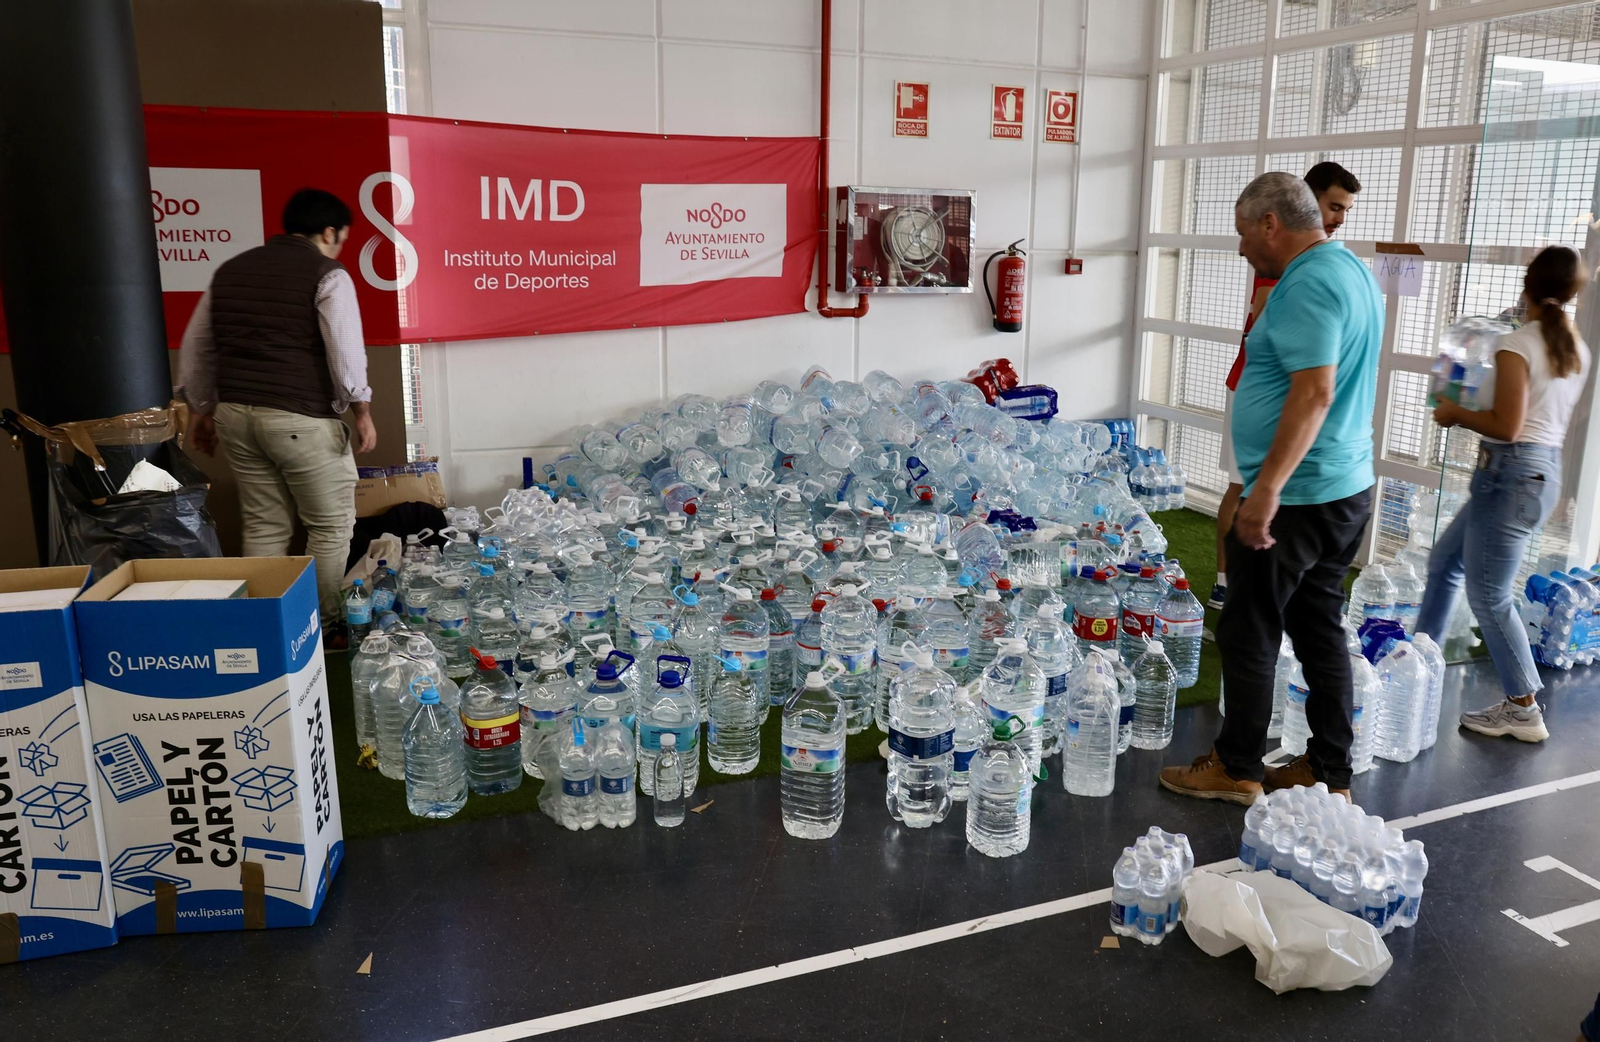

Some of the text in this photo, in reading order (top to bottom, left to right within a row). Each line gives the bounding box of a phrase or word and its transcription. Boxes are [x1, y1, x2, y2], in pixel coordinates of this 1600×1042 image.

[897, 128, 926, 136] INCENDIO
[994, 125, 1022, 137] EXTINTOR
[480, 176, 586, 222] IMD
[157, 229, 232, 243] MIENTO
[664, 231, 765, 245] AYUNTAMIENTO
[158, 248, 210, 262] VILLA
[444, 249, 617, 271] Instituto Municipal
[680, 246, 750, 261] DE SEVILLA
[1380, 256, 1416, 279] AGUA
[474, 271, 589, 293] de Deportes
[127, 655, 211, 671] LIPASAM
[132, 710, 246, 722] USA LAS PAPELERAS
[160, 740, 204, 865] PAPEL Y
[192, 737, 238, 868] CARTÓN
